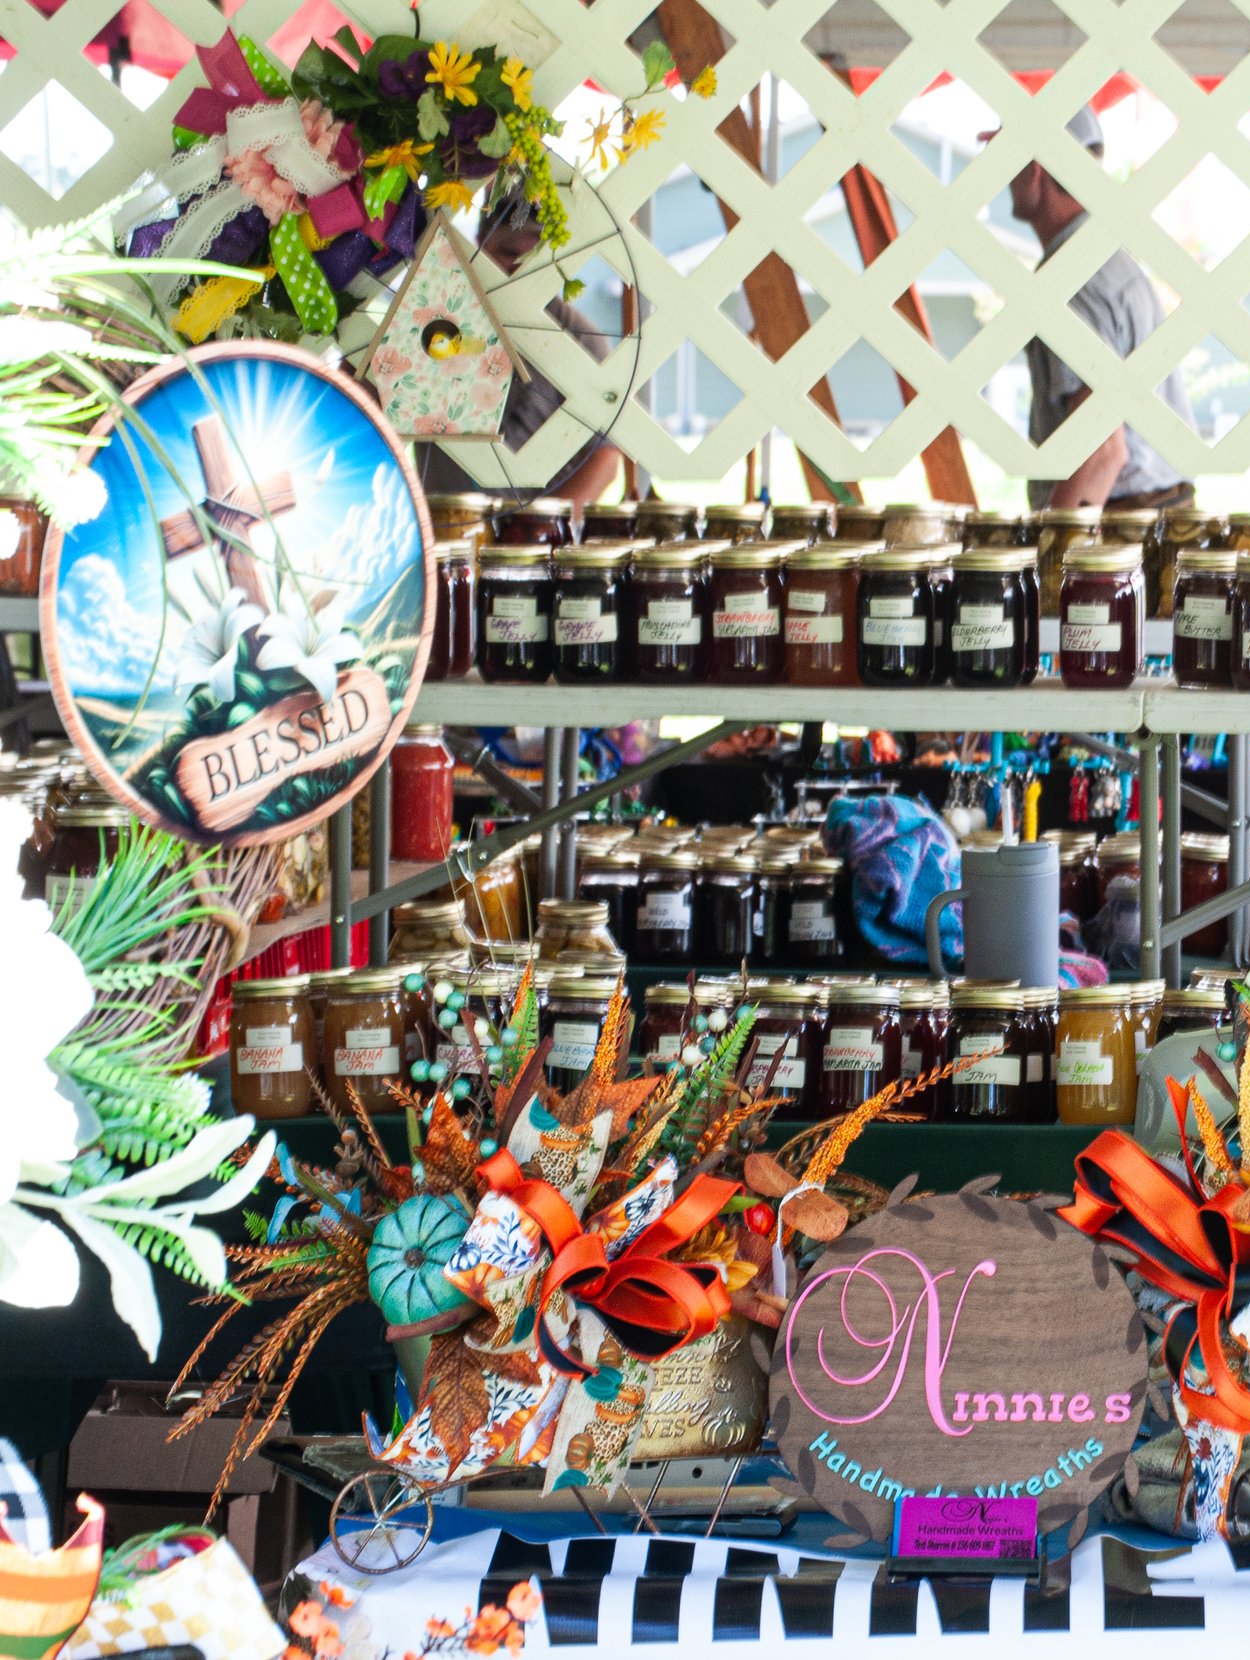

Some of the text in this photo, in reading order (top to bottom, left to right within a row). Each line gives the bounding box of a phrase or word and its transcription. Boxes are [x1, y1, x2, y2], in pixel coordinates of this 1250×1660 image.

[499, 631, 537, 642] JELLY
[563, 631, 603, 641] JELLY
[650, 630, 682, 643] JELLY
[790, 632, 818, 643] JELLY
[1064, 627, 1092, 638] PLUM
[1184, 627, 1222, 638] BUTTER
[960, 636, 991, 648] JELLY
[1066, 639, 1101, 650] JELLY
[200, 690, 368, 800] BLESSED
[239, 1047, 284, 1062] BANANA
[336, 1048, 383, 1062] BANANA
[251, 1059, 281, 1071] JAM
[346, 1060, 375, 1072] JAM
[965, 1071, 997, 1082] JAM
[975, 1435, 1105, 1500] Wreaths
[917, 1523, 1024, 1536] Handmade Wreaths
